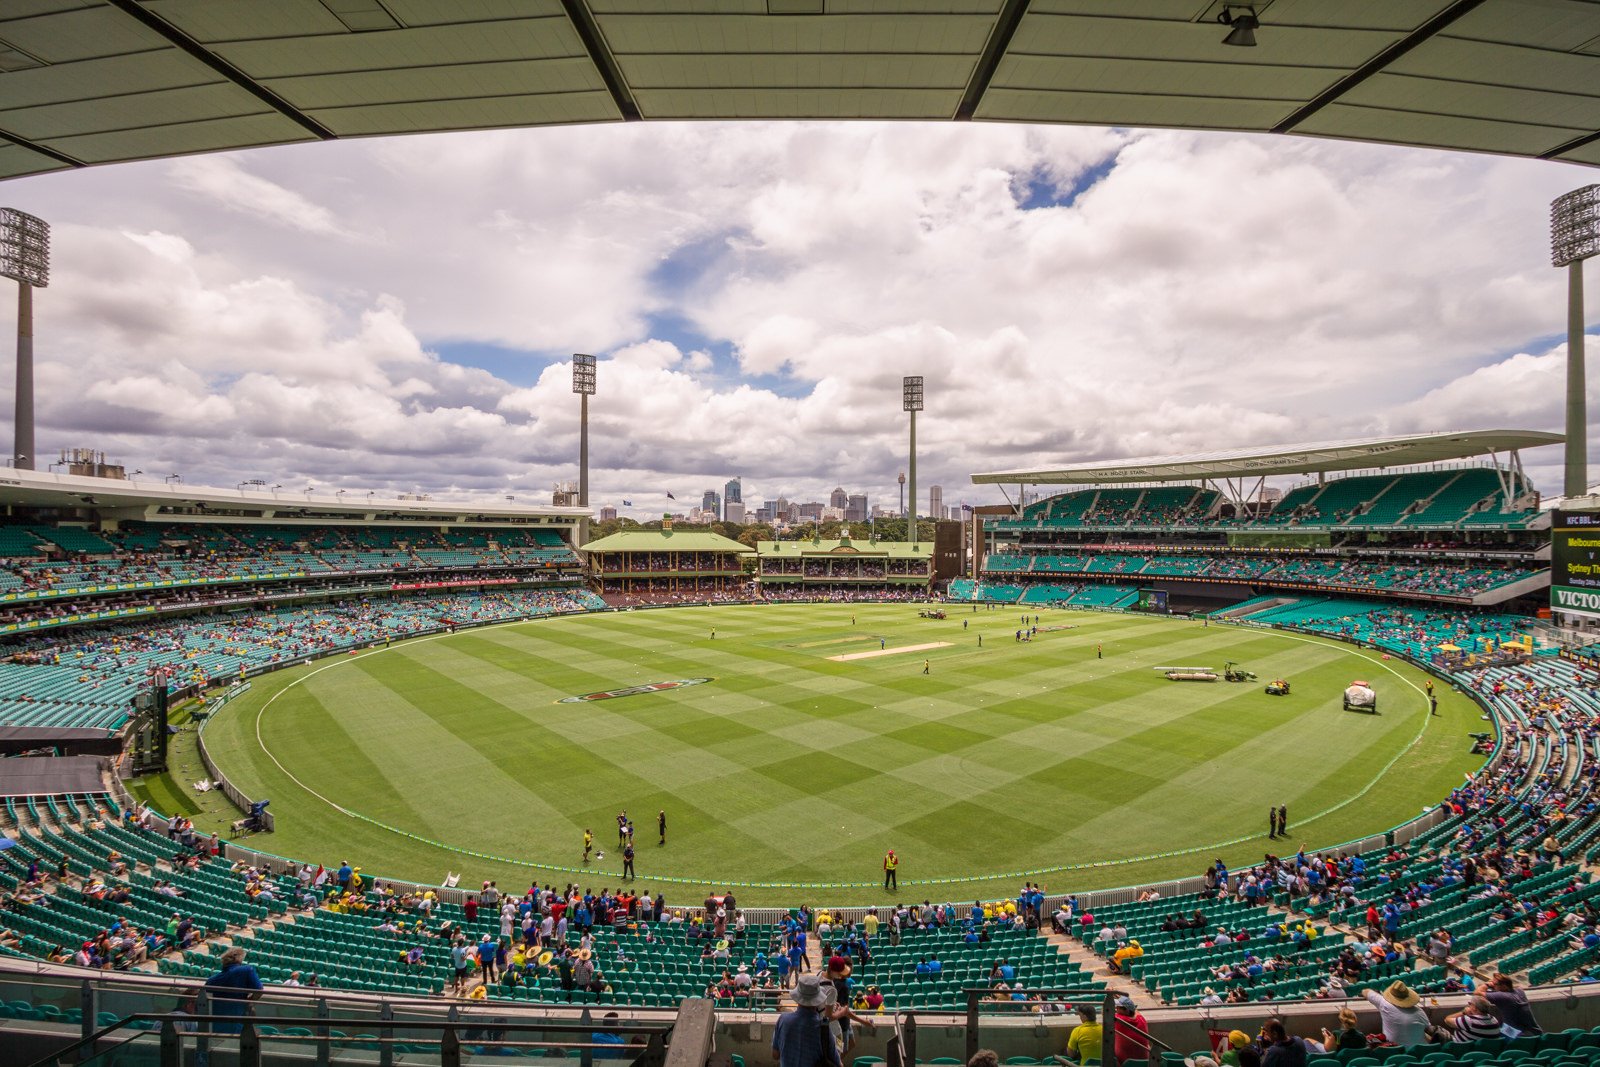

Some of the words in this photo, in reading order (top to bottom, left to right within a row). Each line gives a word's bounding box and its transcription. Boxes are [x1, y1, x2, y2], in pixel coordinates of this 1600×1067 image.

[1567, 516, 1579, 524] KFC
[1579, 516, 1591, 524] BBL
[1568, 538, 1600, 546] Melbourne
[1568, 563, 1591, 575] Sydney
[1558, 590, 1600, 609] VICTO
